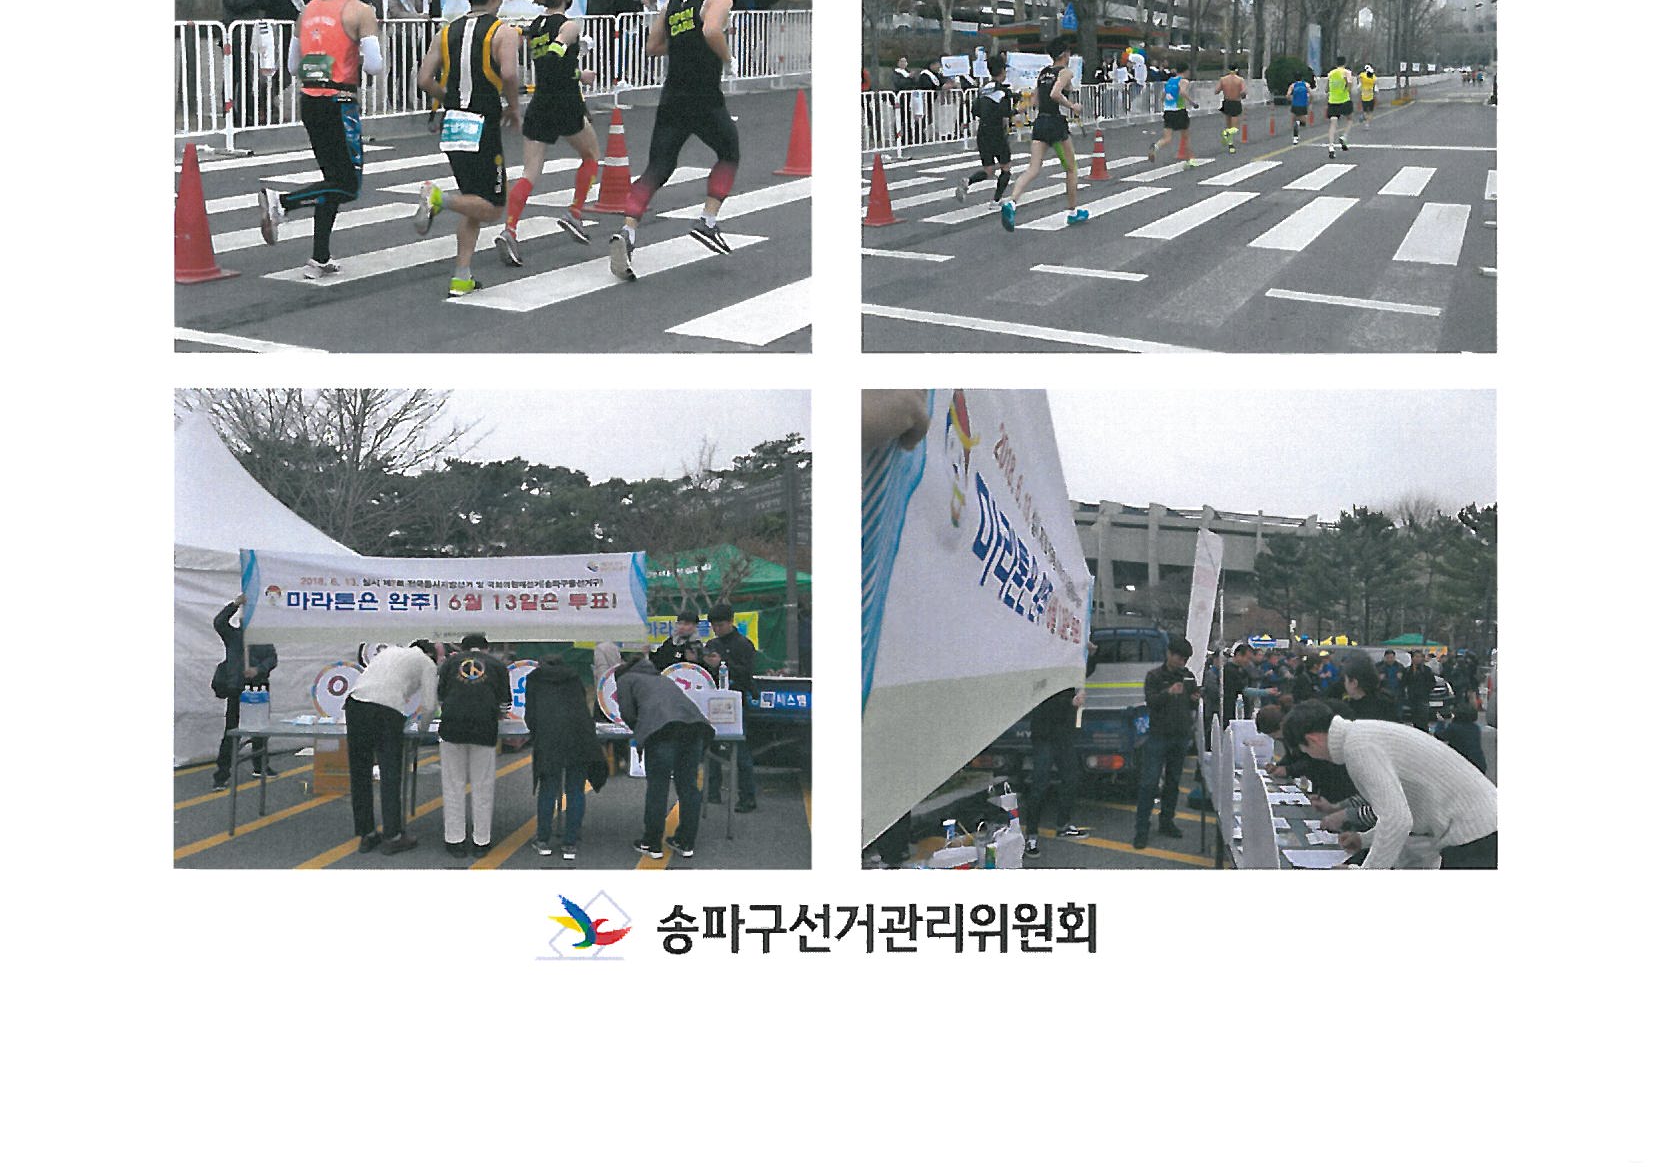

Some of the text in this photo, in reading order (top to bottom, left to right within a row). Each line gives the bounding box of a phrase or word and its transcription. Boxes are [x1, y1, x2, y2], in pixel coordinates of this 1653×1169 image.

[300, 577, 327, 588] 2018.
[287, 591, 618, 612] 마라톤은 완주! 6월 13일은 투표!
[656, 902, 1097, 955] 송파구선거관리위원회
